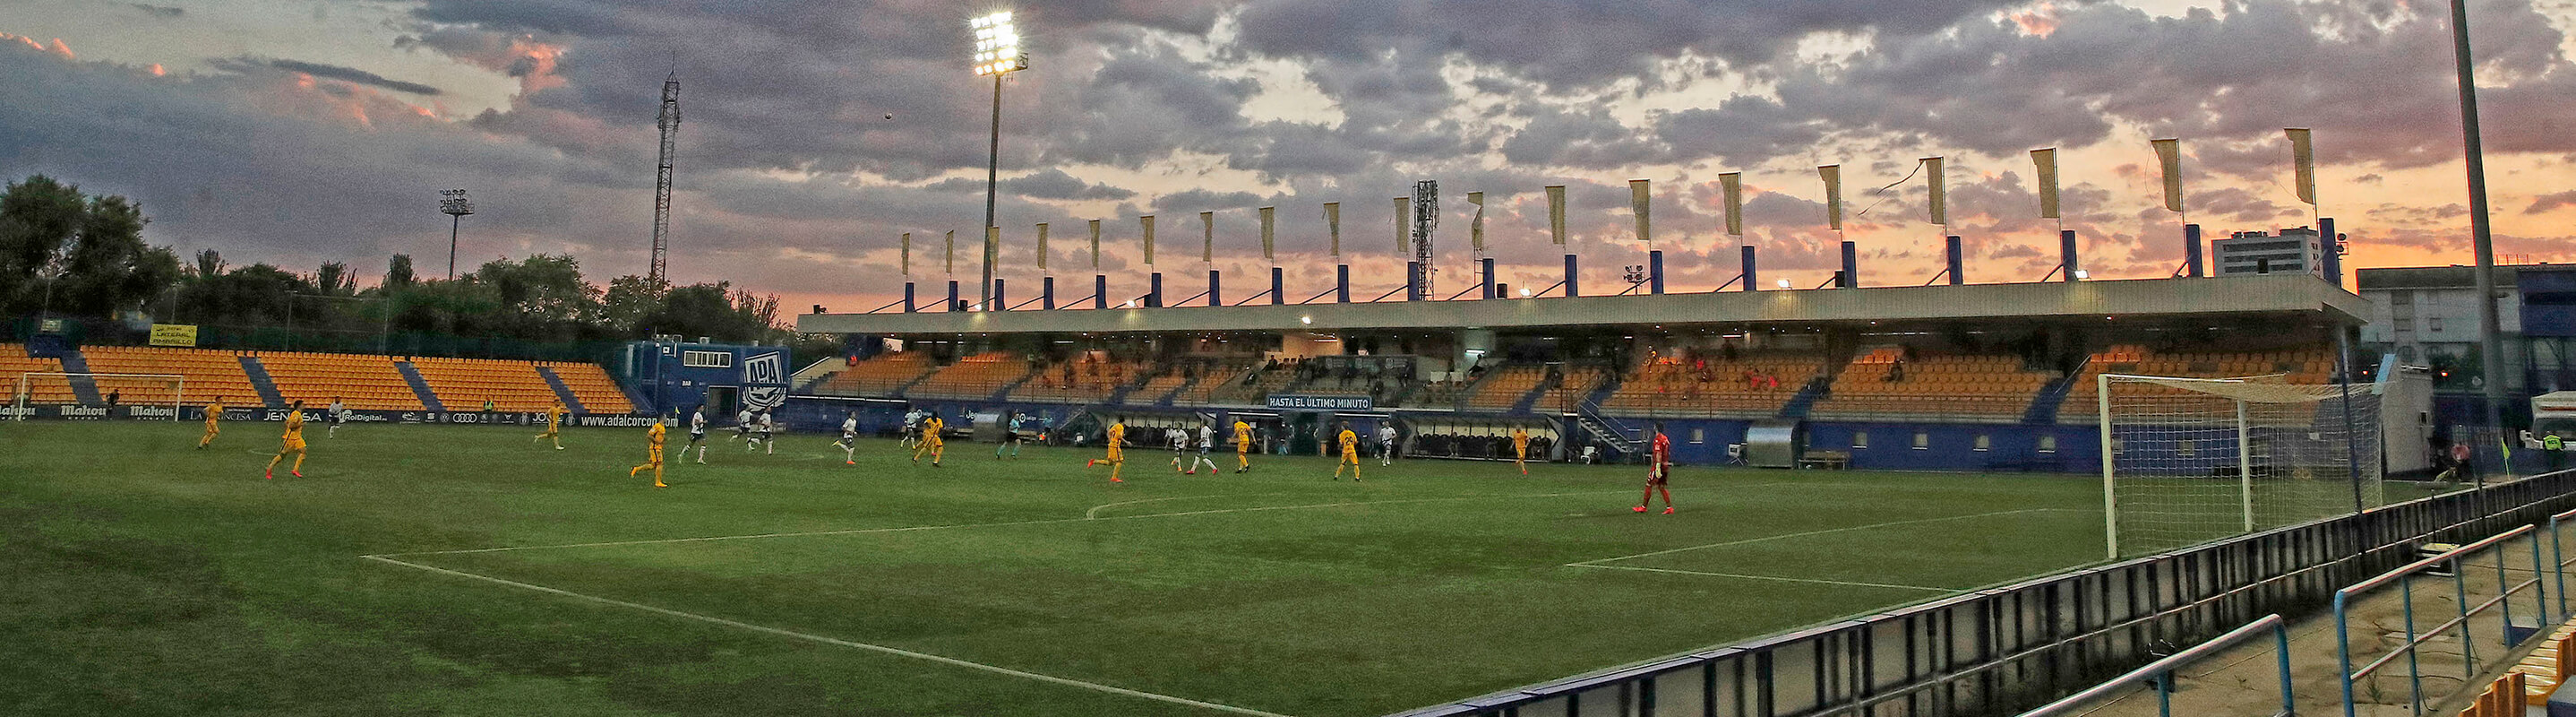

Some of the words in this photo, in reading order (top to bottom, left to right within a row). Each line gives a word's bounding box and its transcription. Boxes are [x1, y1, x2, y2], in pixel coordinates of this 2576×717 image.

[1269, 397, 1294, 408] HASTA
[1295, 398, 1306, 408] EL
[1307, 395, 1335, 409] ÚLTIMO
[1336, 399, 1369, 409] MINUTO
[60, 404, 107, 416] Mahou
[130, 405, 174, 417] Mahou
[190, 410, 202, 420] LA
[263, 412, 322, 421] JENSA
